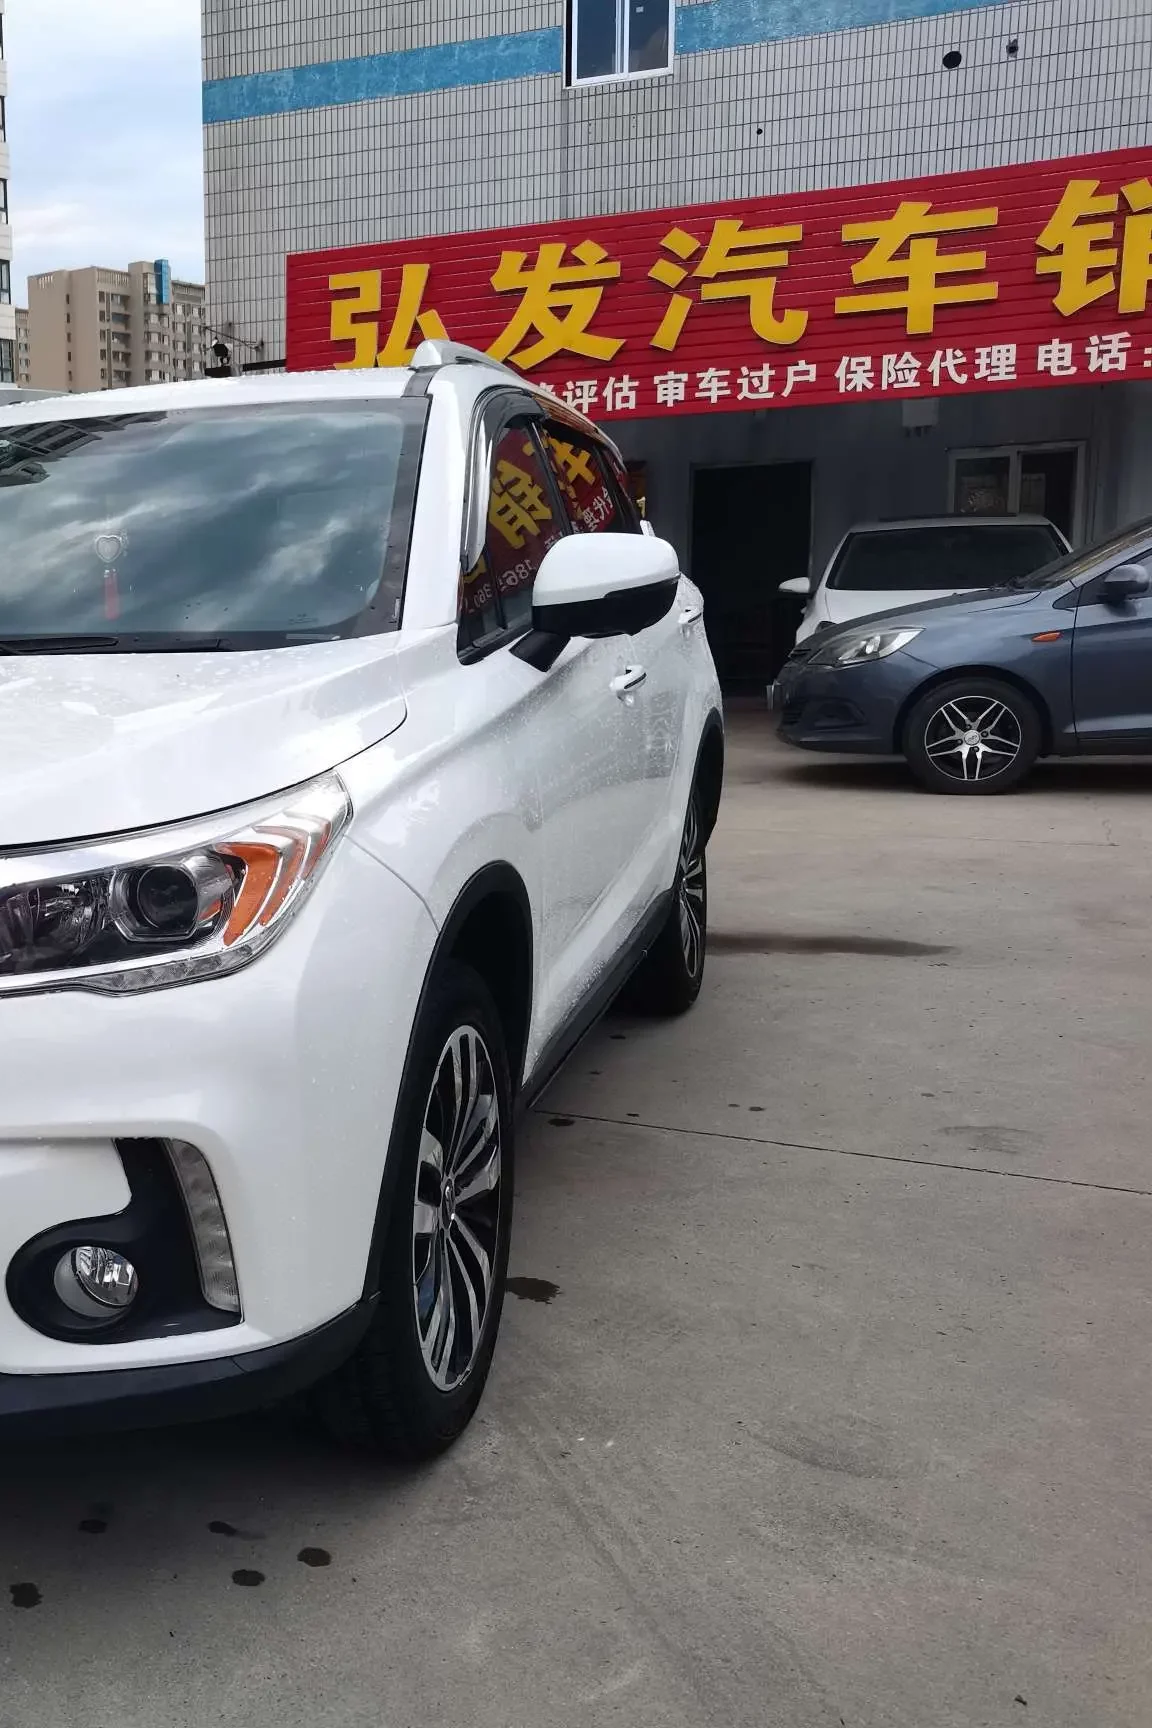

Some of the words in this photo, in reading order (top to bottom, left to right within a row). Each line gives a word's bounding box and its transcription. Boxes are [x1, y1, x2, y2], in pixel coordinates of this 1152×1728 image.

[539, 374, 639, 413] 评估
[652, 354, 818, 407] 审车过户
[835, 342, 1017, 392] 保险代理
